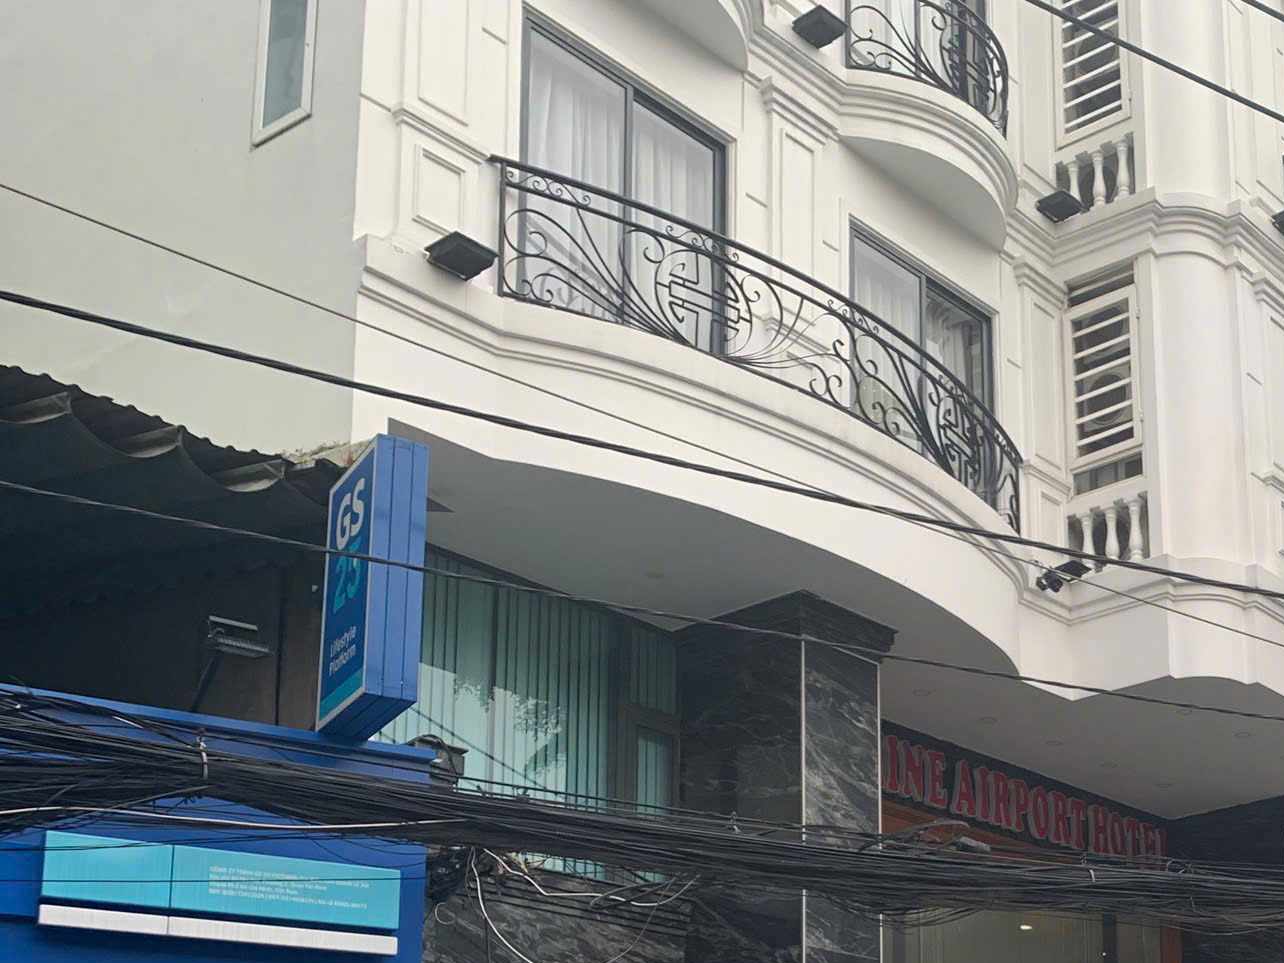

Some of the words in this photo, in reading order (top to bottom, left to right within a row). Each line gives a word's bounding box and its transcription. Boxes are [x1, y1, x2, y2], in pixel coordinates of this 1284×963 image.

[335, 477, 365, 551] GS
[332, 536, 362, 616] 25
[328, 643, 357, 677] Platform
[329, 624, 357, 658] Lifestyle
[878, 735, 947, 809] INE
[949, 759, 1086, 850] AIRPORT
